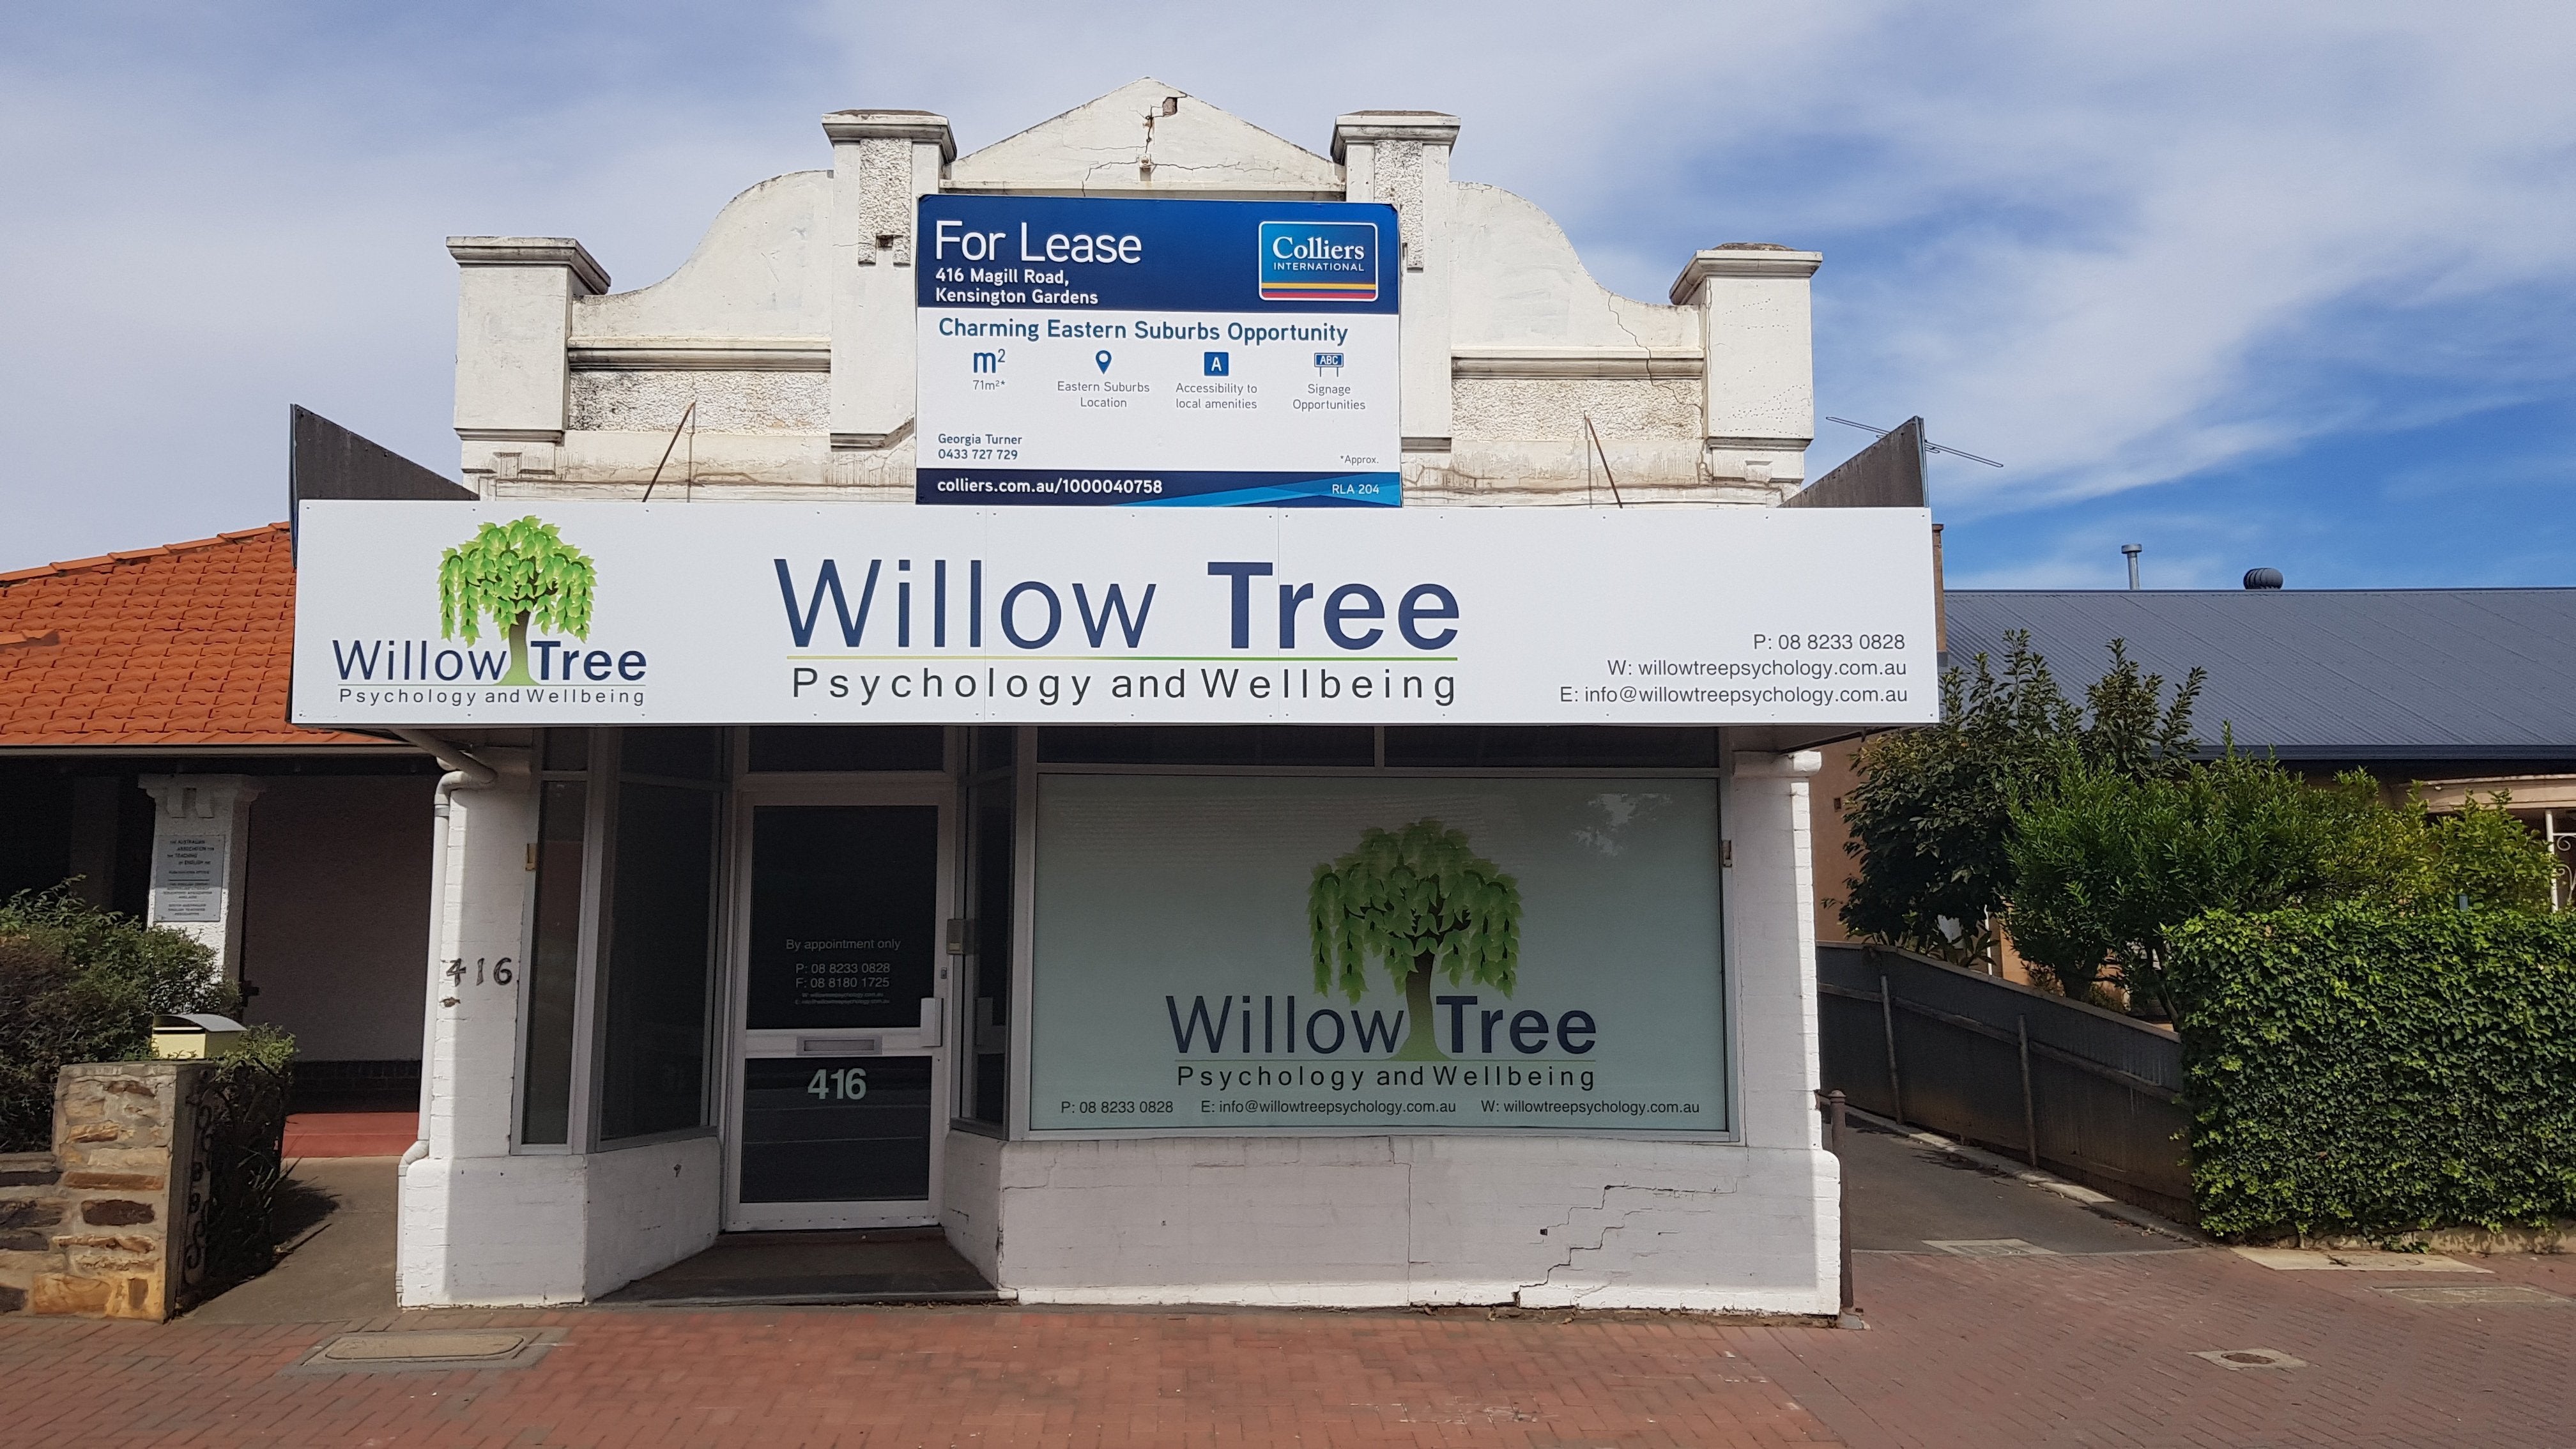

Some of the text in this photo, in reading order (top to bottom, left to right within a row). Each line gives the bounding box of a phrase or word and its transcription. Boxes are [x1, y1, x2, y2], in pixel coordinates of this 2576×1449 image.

[935, 220, 1142, 263] For Lease
[1273, 236, 1365, 259] Colliers
[1273, 263, 1364, 272] INTERNATIONAL
[935, 269, 1069, 287] 416 Magill Road,
[935, 288, 1098, 305] Kensington Gardens
[939, 318, 1347, 346] Charming Eastern Suburbs Opportunity
[1320, 355, 1338, 365] ABC
[1057, 381, 1150, 393] Eastern Suburbs
[1176, 383, 1257, 397] Accessibility to
[1308, 384, 1351, 397] Signage
[1080, 397, 1127, 408] Location
[1176, 398, 1257, 410] local amenities
[1292, 399, 1366, 413] Opportunities
[938, 434, 1023, 448] Georgia Turner
[938, 450, 1018, 459] 0433 727 729
[938, 479, 1162, 494] colliers.com.au/1000040758
[1332, 484, 1379, 494] RLA 204
[774, 558, 1459, 650] Willow Tree
[1754, 634, 1905, 650] P: 08 8233 0828
[332, 640, 647, 680] Willow Tree
[1608, 660, 1906, 679] W: willowtreepsychology.com.au
[793, 667, 1455, 705] Psychology and Wellbeing
[341, 689, 644, 705] Psychology and Wellbeing
[1561, 686, 1907, 705] E: info@willowtreepsychology.com.au
[786, 940, 901, 951] By appointment only
[446, 957, 512, 987] 416
[796, 963, 890, 974] P: 08 8233 0828
[796, 977, 889, 988] F: 08 8180 1725
[1165, 995, 1596, 1055] Willow Tree
[808, 1068, 866, 1100] 416
[1177, 1066, 1594, 1091] Psychology and Wellbeing
[1061, 1101, 1173, 1114] P: 08 8233 0828
[1202, 1100, 1456, 1116] E: info@willowtreepsychology.com.au
[1481, 1100, 1699, 1116] W: willowtreepsychology.com.au
